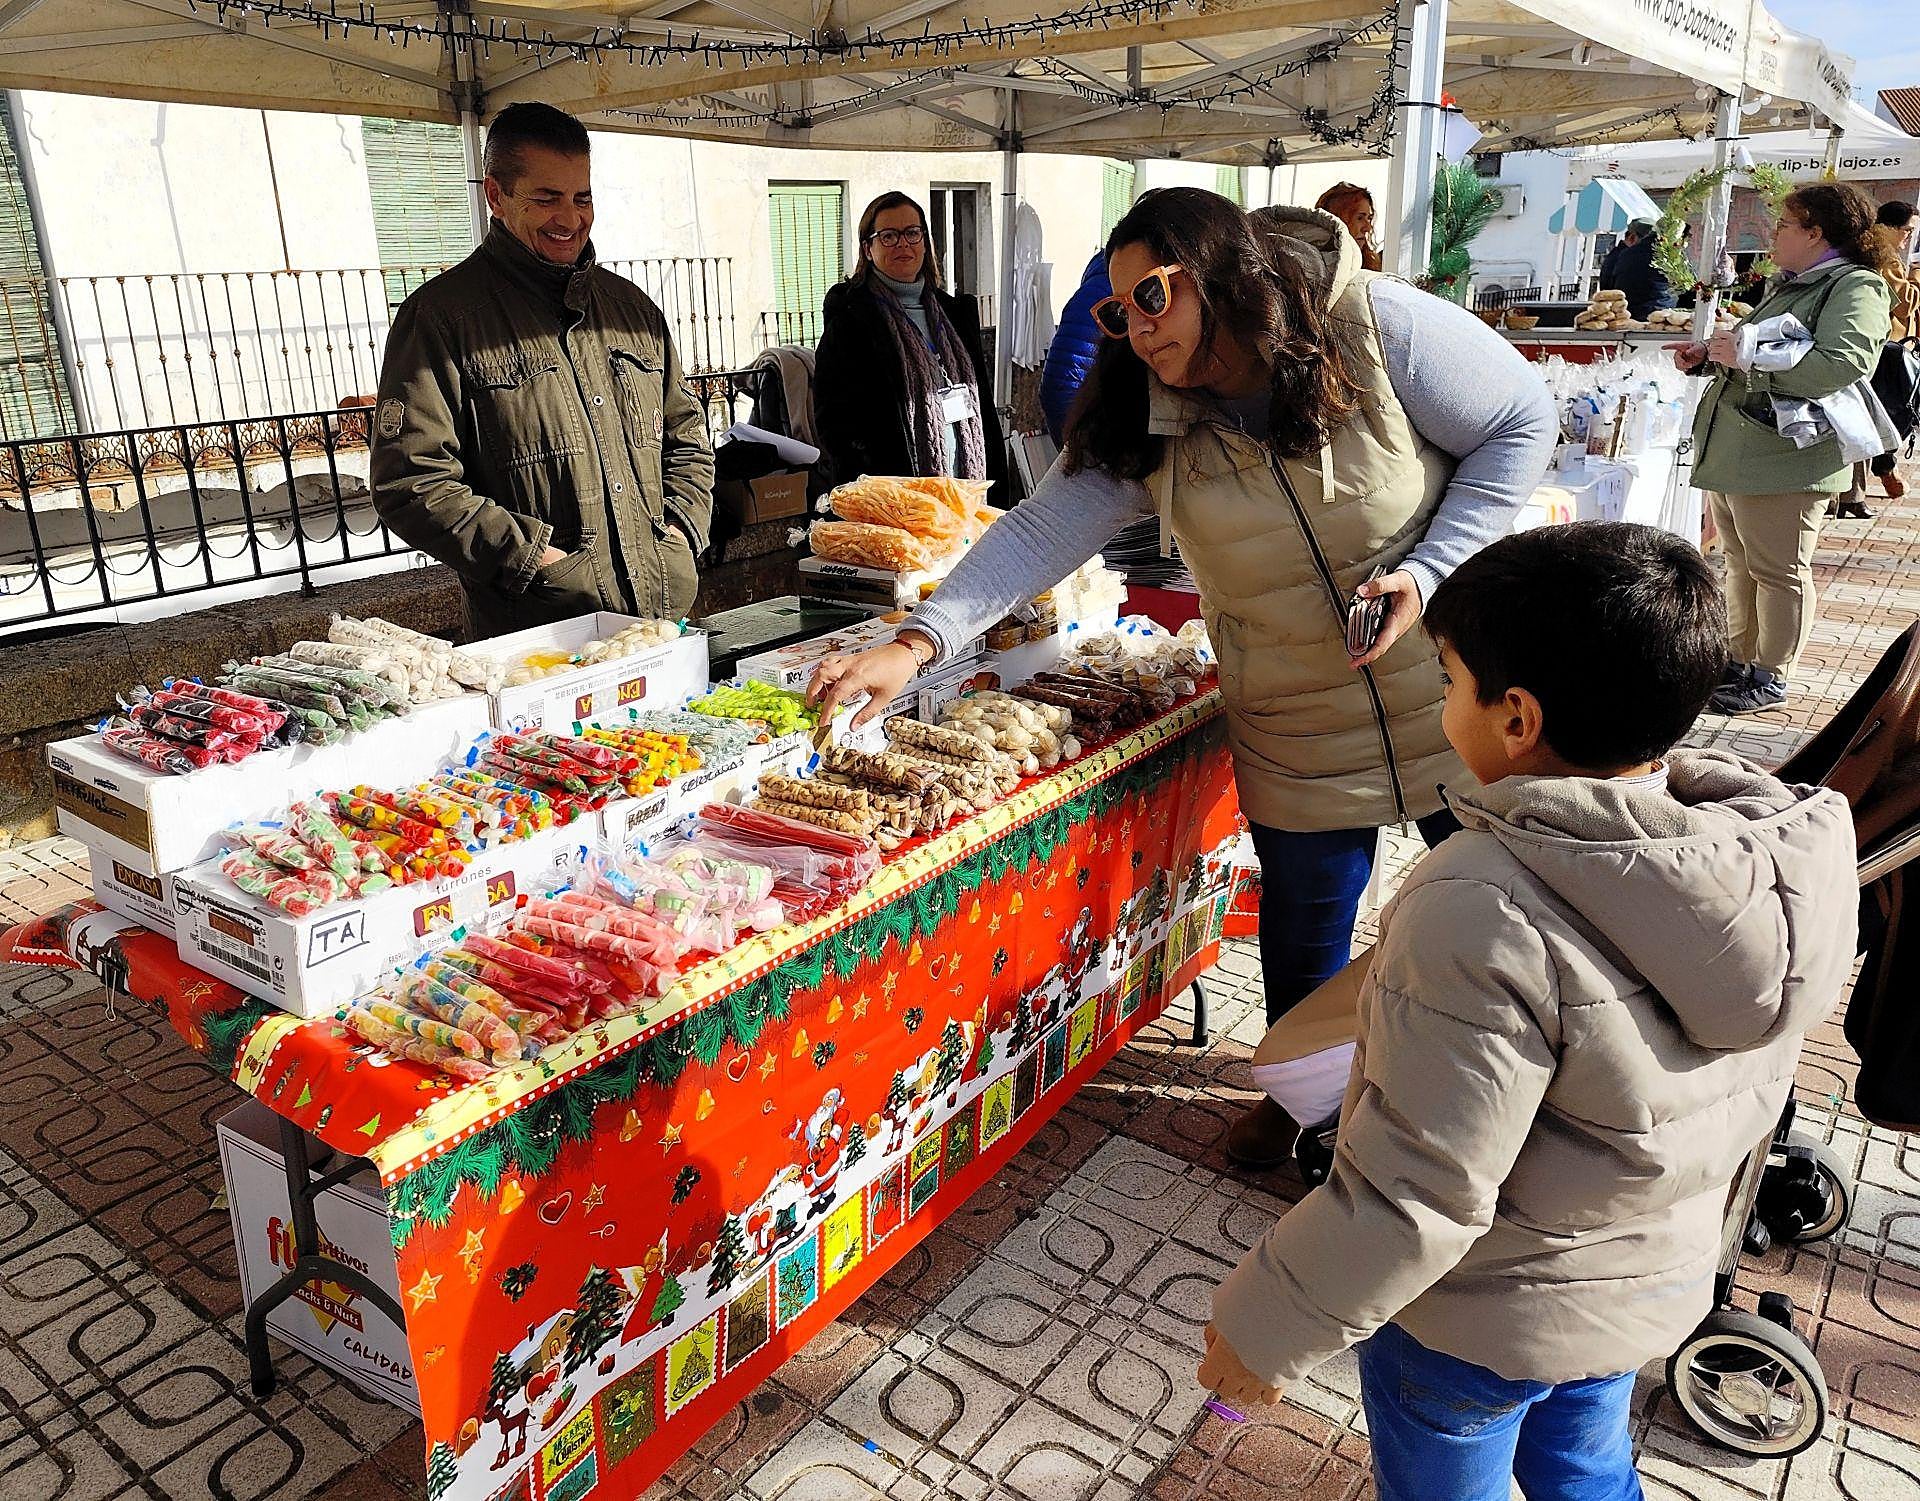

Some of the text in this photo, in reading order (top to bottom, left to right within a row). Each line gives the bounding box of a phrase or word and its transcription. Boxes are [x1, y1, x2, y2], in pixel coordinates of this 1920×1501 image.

[116, 864, 161, 898] ENCASA
[334, 1305, 359, 1326] Nuts
[343, 1336, 412, 1380] CALIDAD
